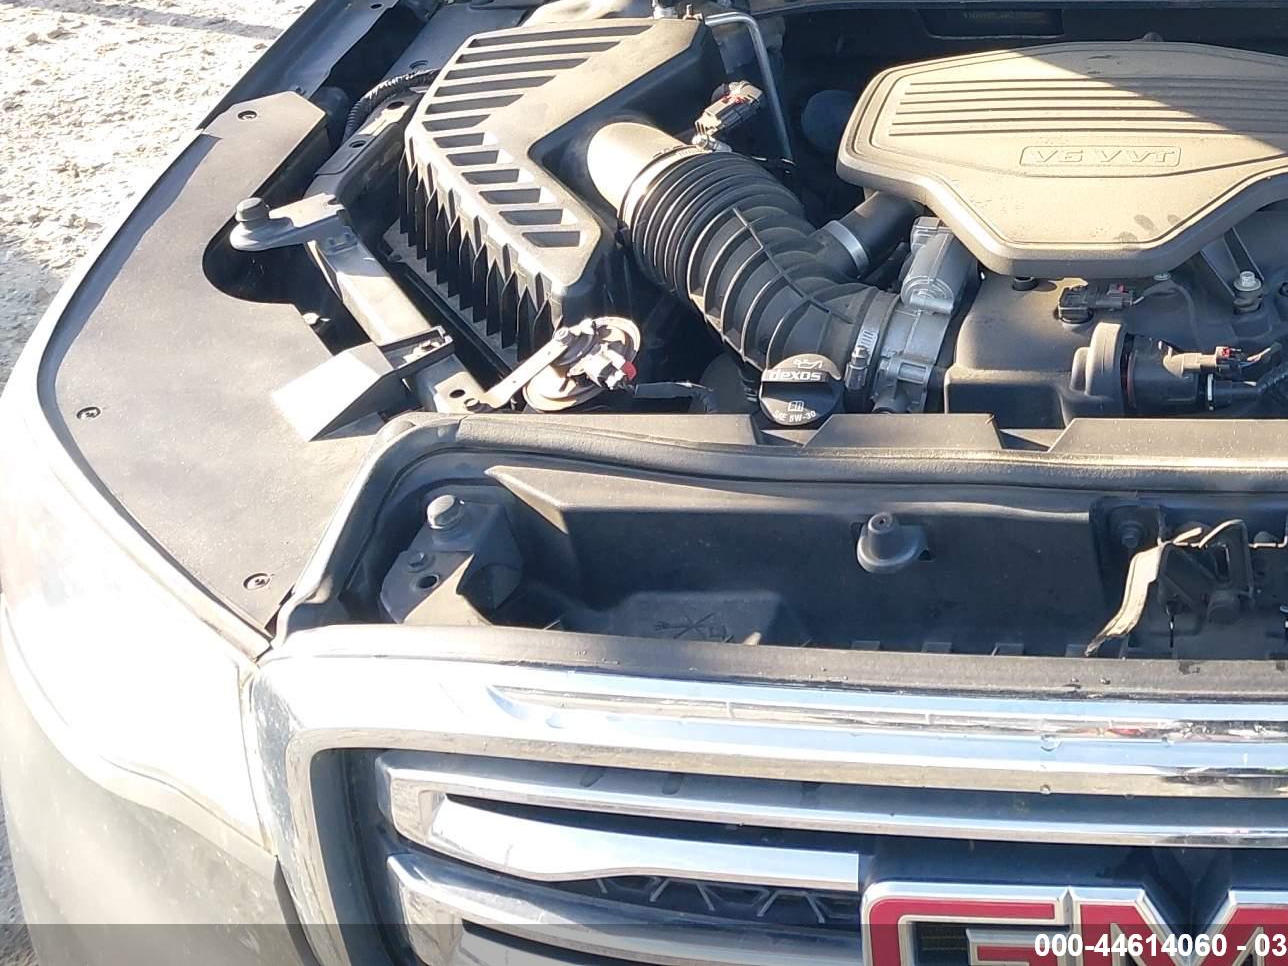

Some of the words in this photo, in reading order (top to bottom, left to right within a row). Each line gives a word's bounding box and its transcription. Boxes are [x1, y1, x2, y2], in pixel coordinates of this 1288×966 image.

[1030, 149, 1084, 163] V6
[1094, 149, 1176, 163] VVT
[769, 369, 821, 381] dexos
[789, 410, 817, 423] 5W-30
